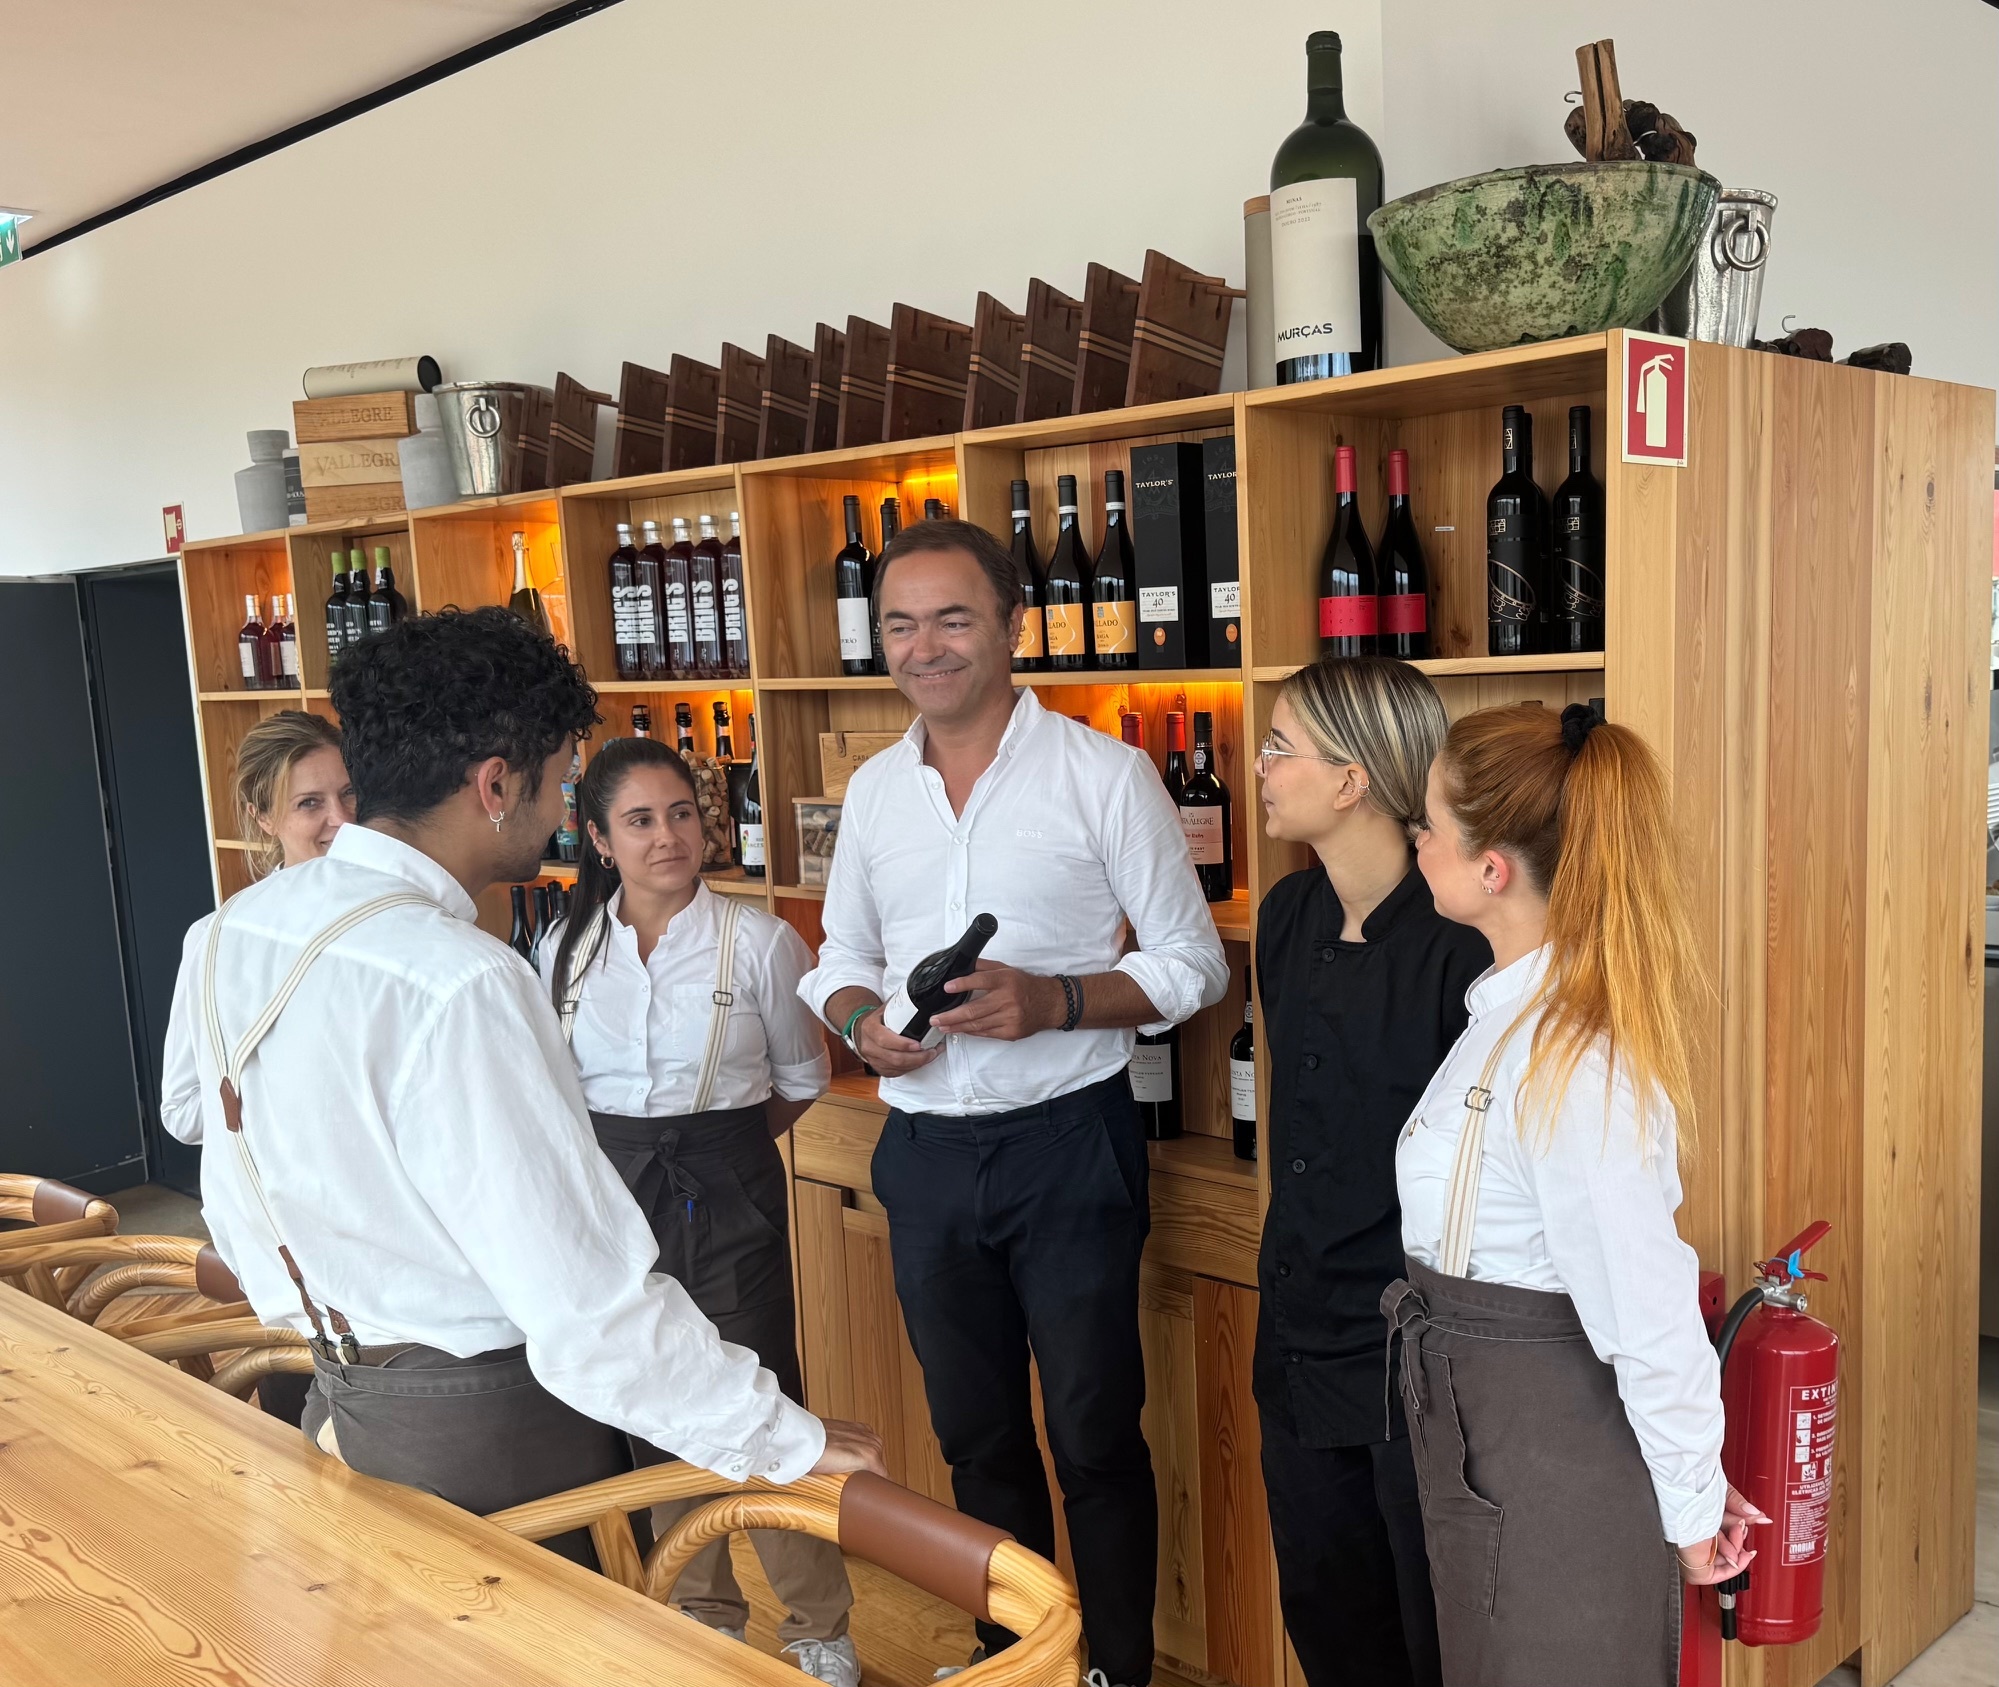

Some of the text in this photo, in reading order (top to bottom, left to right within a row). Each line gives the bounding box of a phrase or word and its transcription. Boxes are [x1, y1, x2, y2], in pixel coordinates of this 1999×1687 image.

[1277, 323, 1333, 343] MURÇAS
[1135, 479, 1174, 488] TAYLOR'S
[1152, 598, 1164, 608] 40
[1224, 593, 1236, 604] 40
[1016, 829, 1044, 839] BOSS
